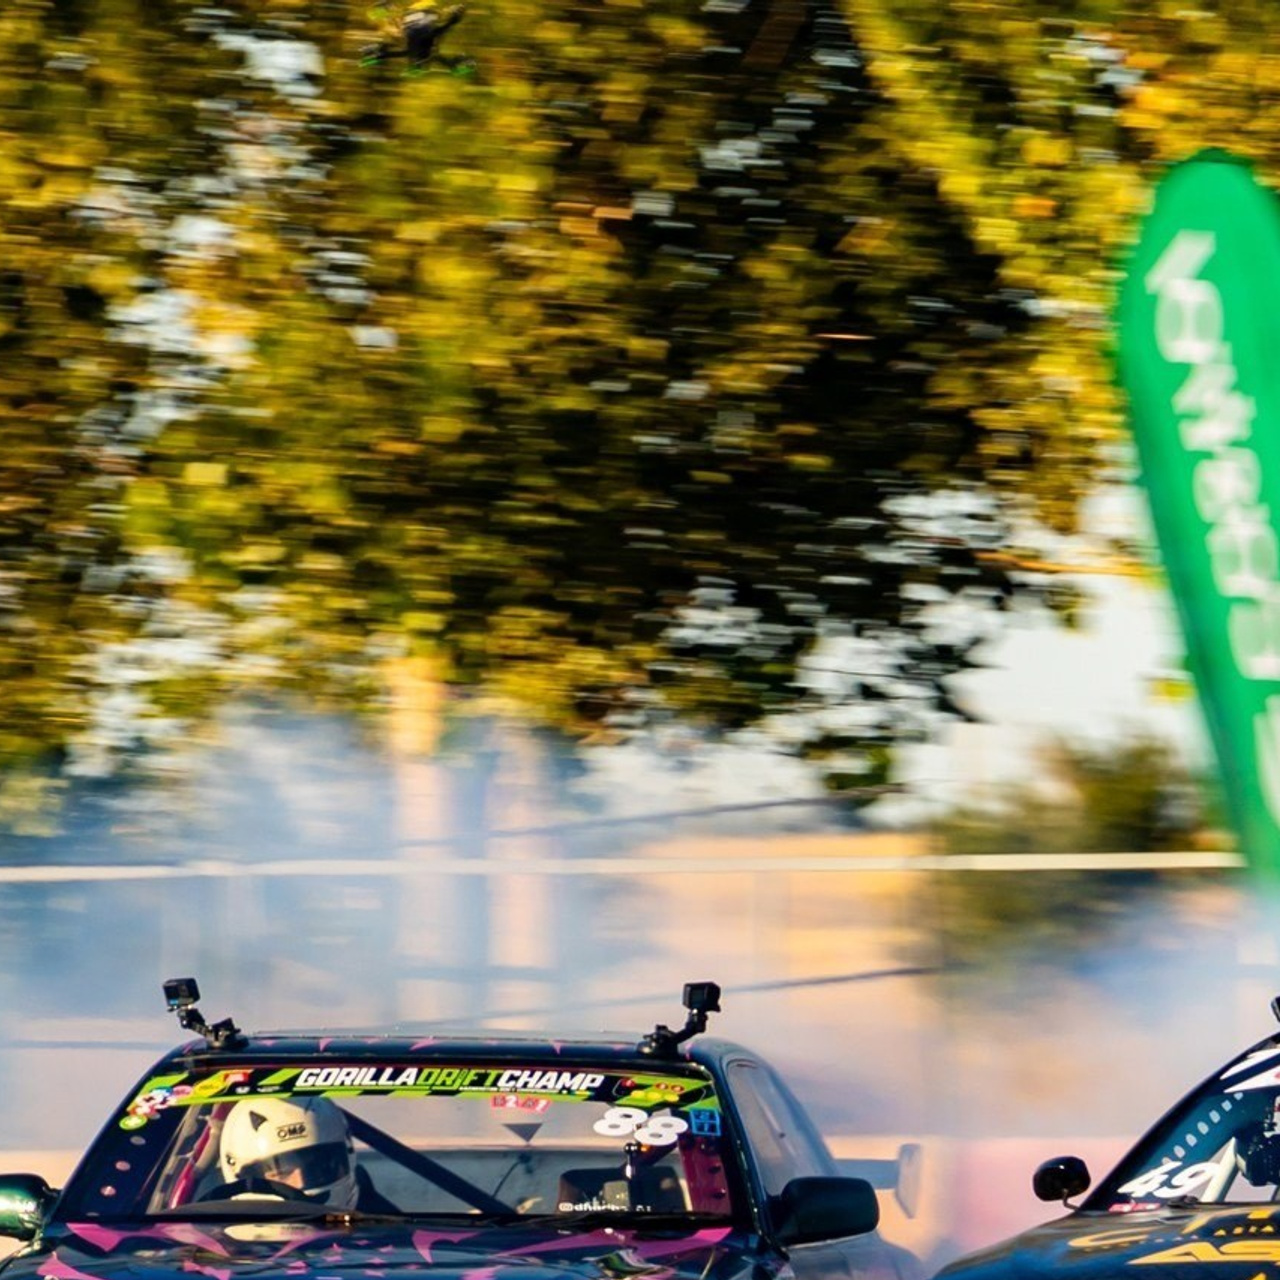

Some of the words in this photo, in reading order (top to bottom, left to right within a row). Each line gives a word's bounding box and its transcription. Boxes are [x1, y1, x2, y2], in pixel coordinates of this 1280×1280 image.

[277, 1124, 306, 1139] OMP
[593, 1107, 689, 1146] 88
[1117, 1160, 1225, 1198] 49
